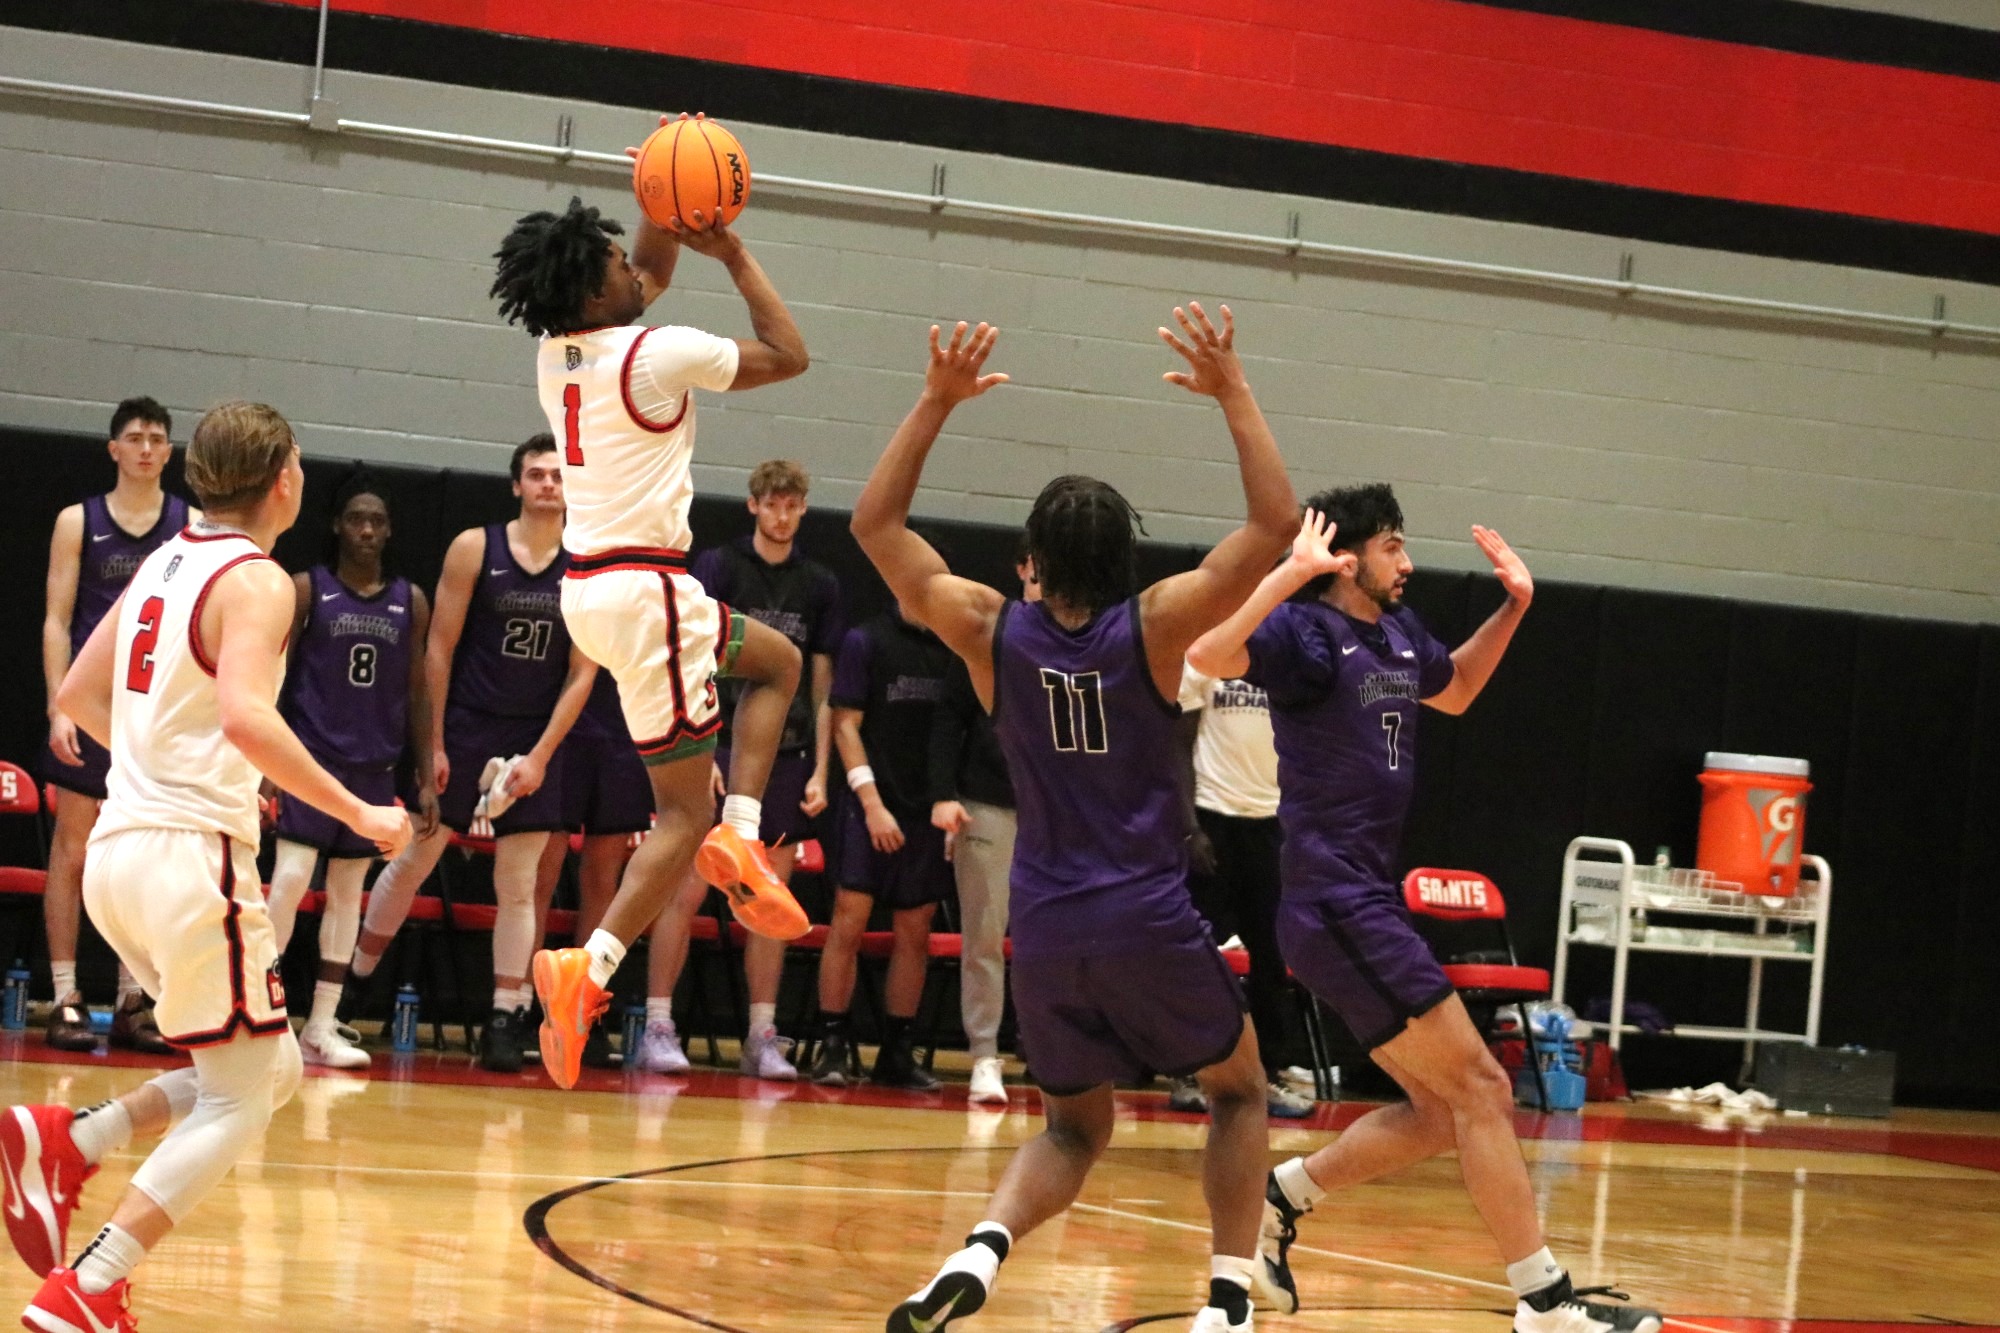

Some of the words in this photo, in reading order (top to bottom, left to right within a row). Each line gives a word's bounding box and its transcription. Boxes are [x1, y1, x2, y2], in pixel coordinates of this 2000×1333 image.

[726, 152, 745, 207] NCAA
[563, 383, 585, 467] 1
[126, 595, 165, 695] 2
[348, 643, 377, 688] 8
[501, 617, 554, 660] 21
[1039, 667, 1109, 754] 11
[1382, 711, 1402, 770] 7
[1768, 797, 1796, 832] G
